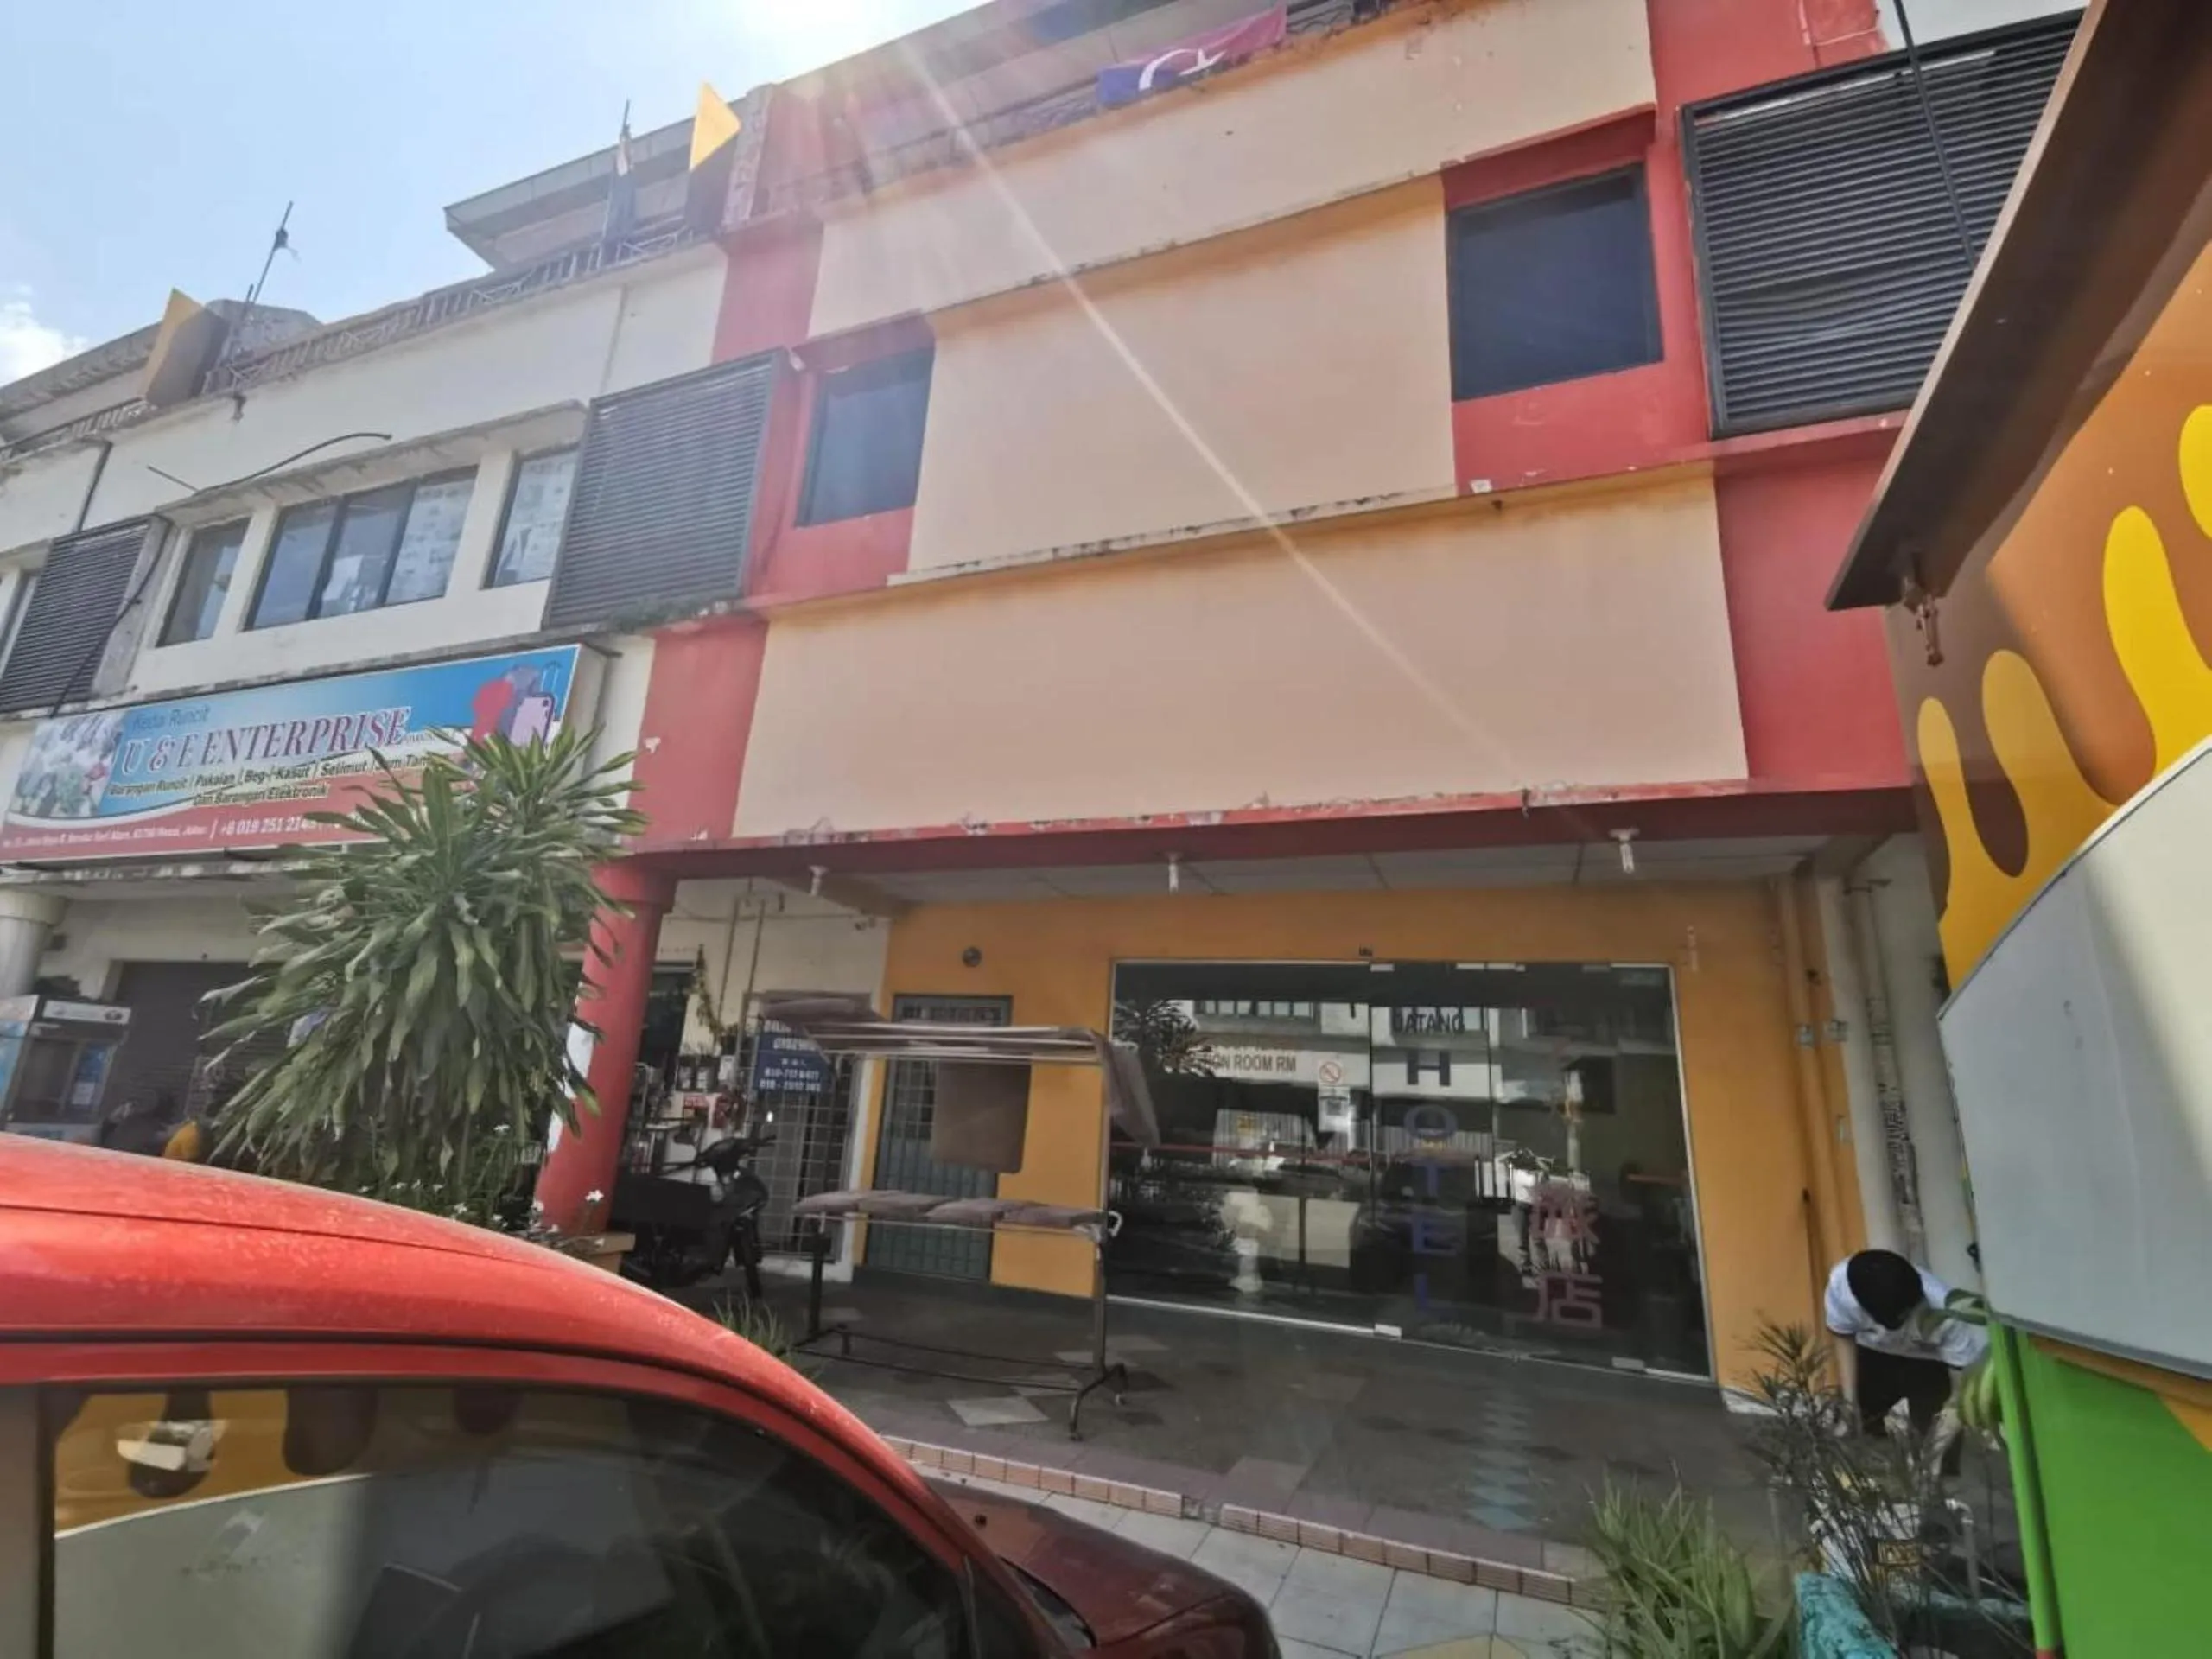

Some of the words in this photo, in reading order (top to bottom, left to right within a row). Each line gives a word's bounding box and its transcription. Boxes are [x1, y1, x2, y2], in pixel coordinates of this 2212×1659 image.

[122, 737, 151, 776] U
[148, 734, 176, 773] &
[176, 732, 200, 768] E
[200, 707, 412, 766] ENTERPRISE
[321, 760, 367, 776] Selimut
[268, 783, 327, 799] Elektronik
[1234, 1053, 1274, 1071] ROOM
[1276, 1055, 1297, 1072] RM
